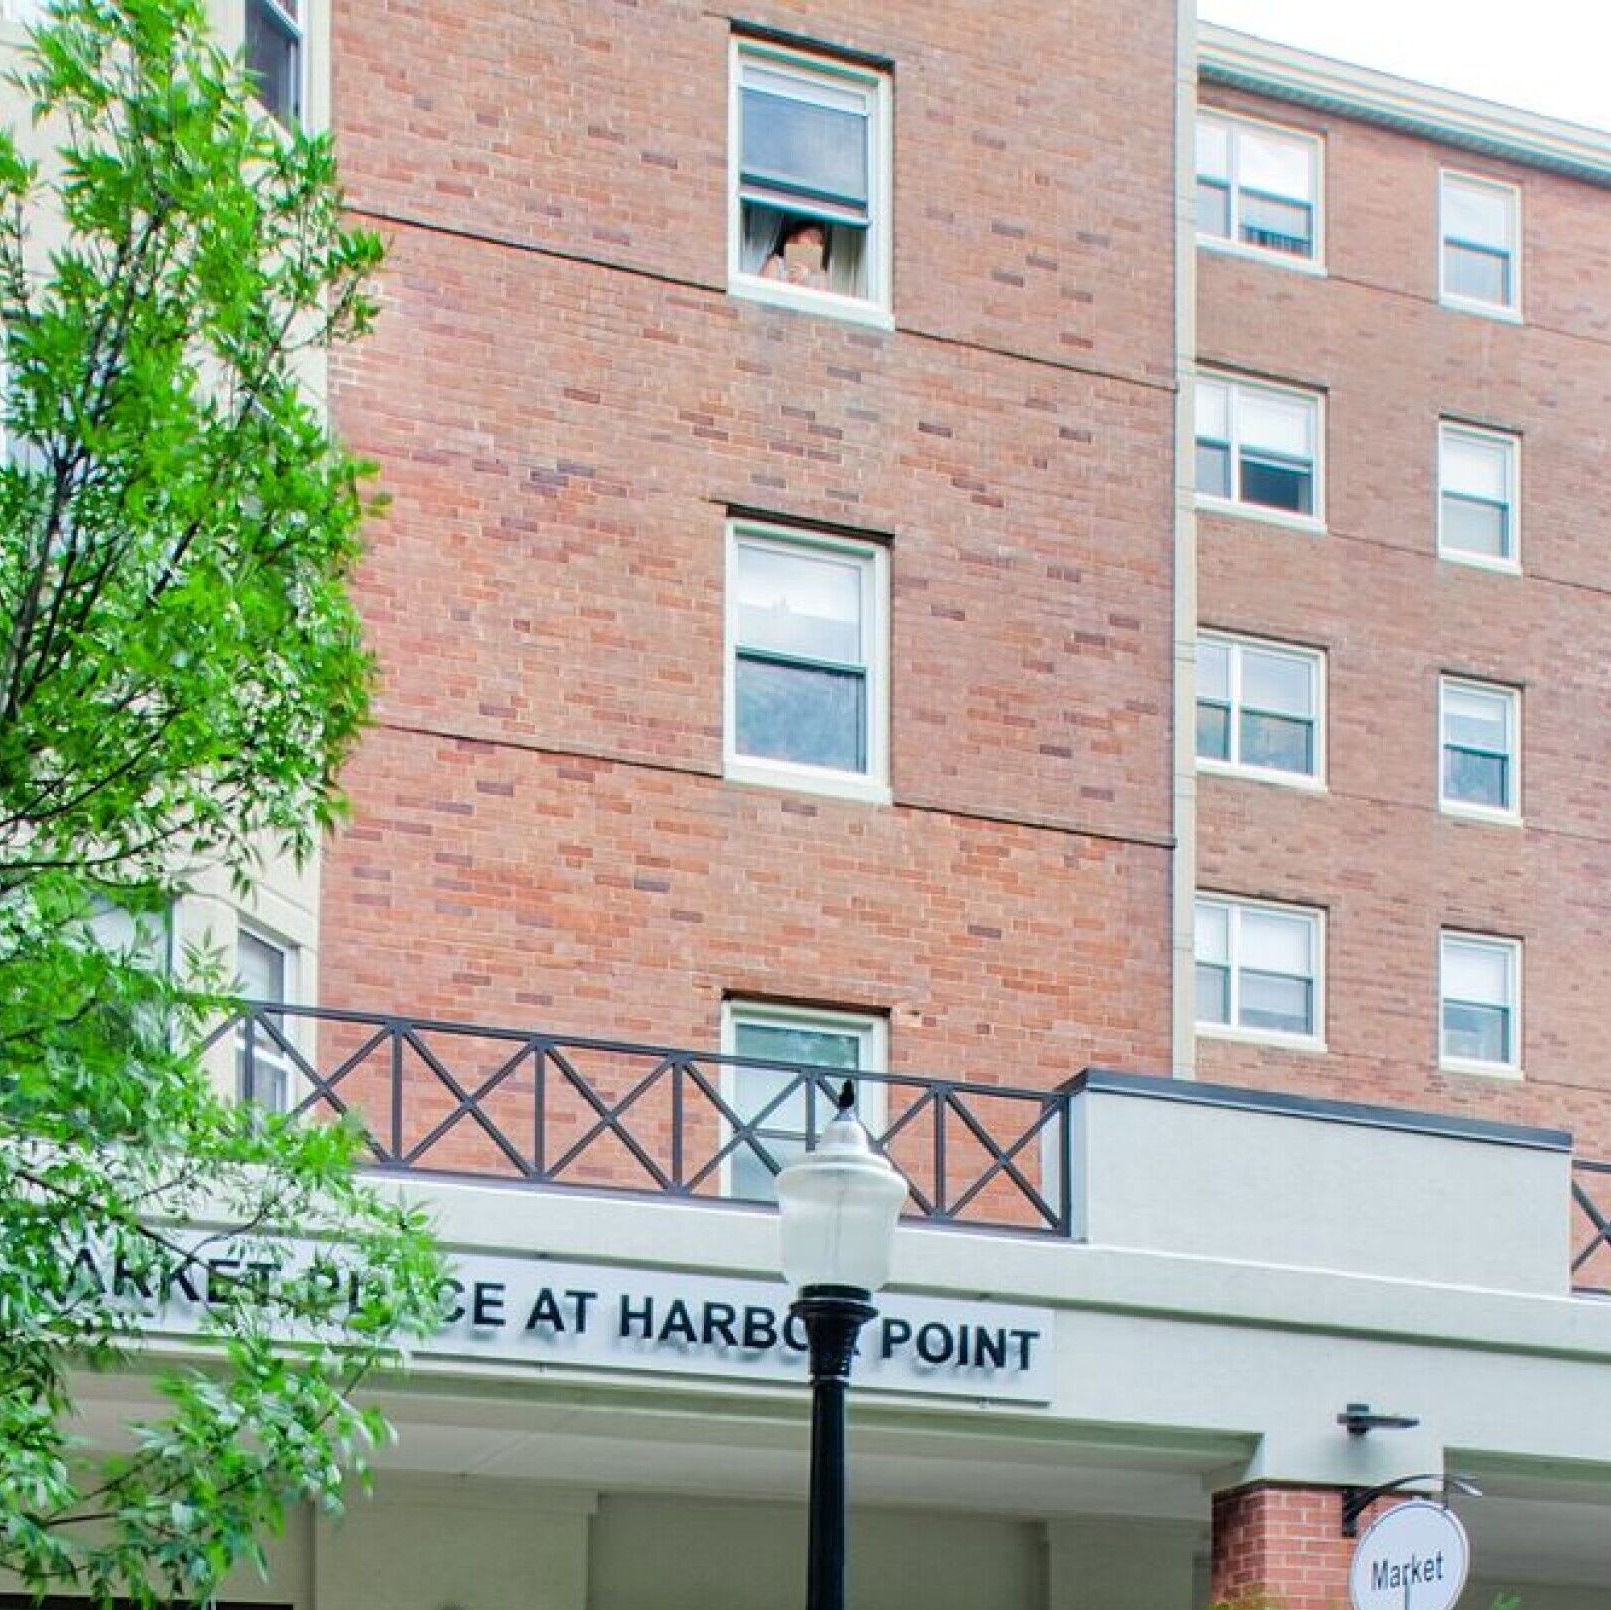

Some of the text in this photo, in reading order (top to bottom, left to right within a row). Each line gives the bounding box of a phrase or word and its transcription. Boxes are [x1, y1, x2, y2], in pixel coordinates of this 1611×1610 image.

[29, 1246, 1040, 1371] ARKET PLCE AT HARBO POINT
[1371, 1551, 1445, 1591] Market
